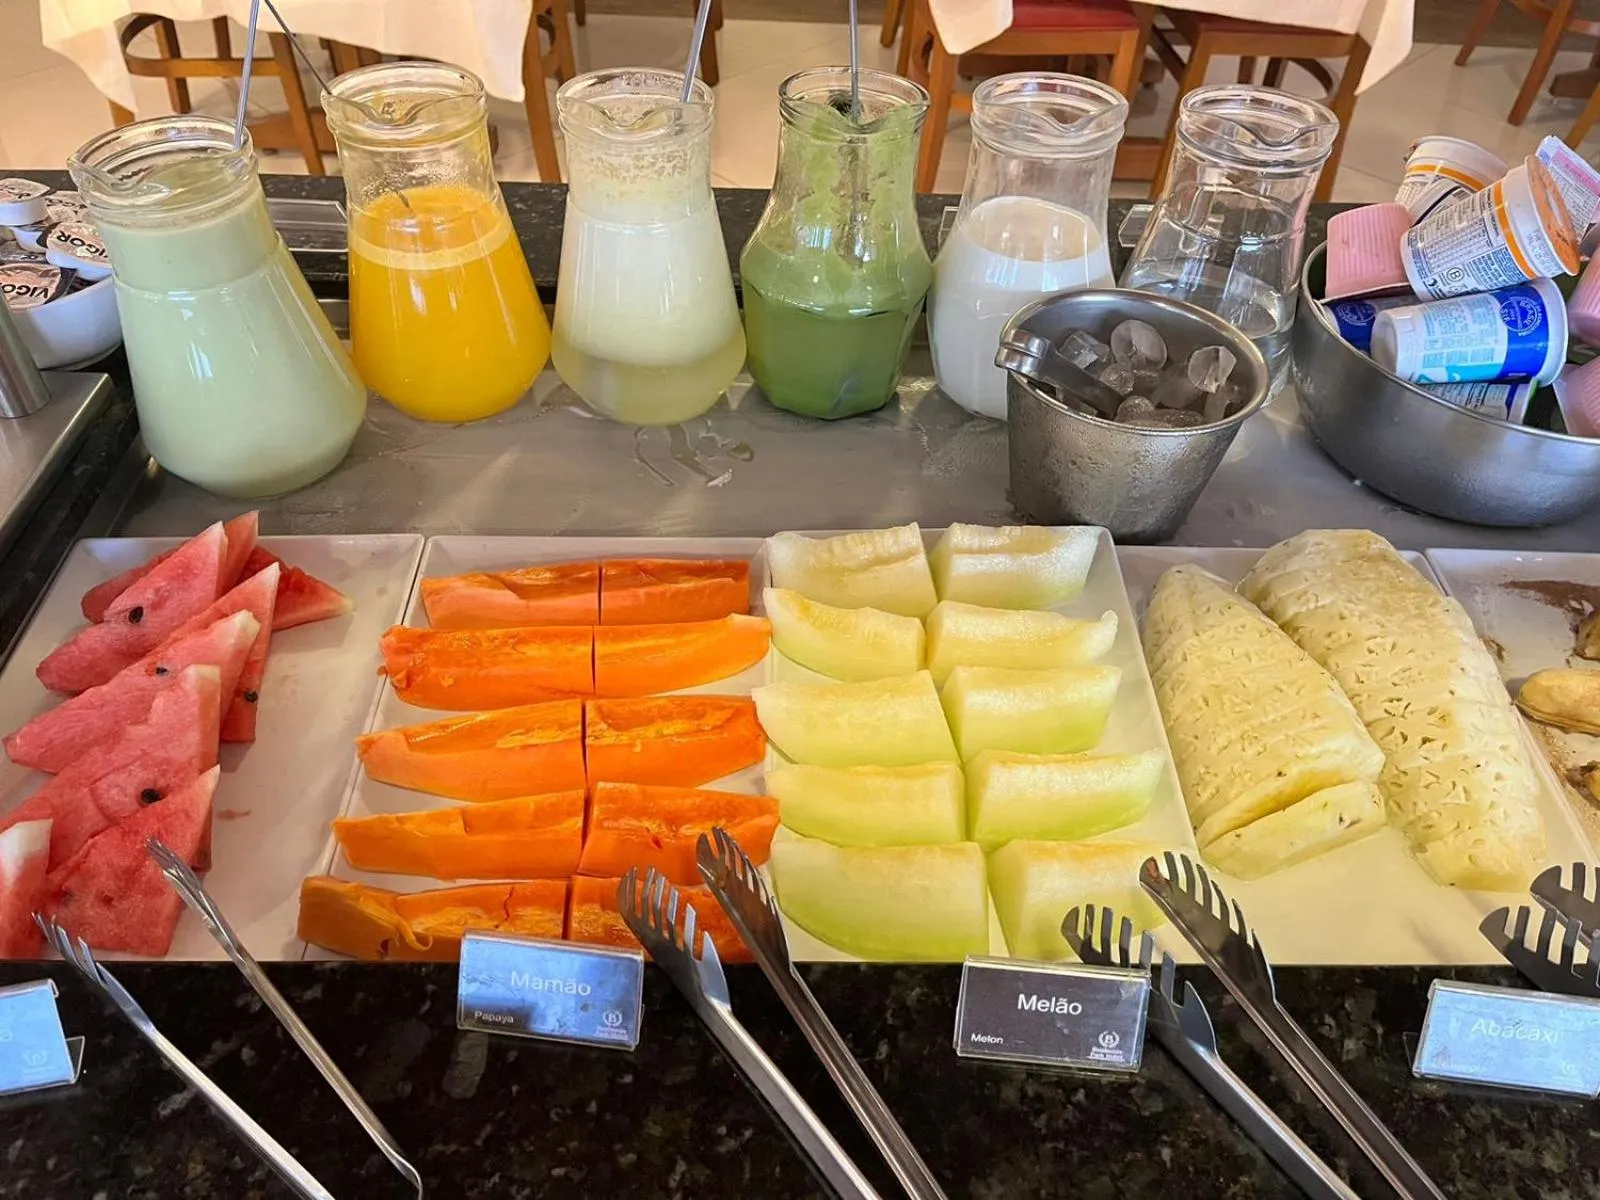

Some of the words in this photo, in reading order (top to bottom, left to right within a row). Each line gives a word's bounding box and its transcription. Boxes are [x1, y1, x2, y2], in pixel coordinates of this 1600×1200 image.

[0, 281, 49, 299] VIGO
[511, 970, 592, 996] Mamão
[1017, 993, 1083, 1016] Melão
[474, 1010, 514, 1024] Papaya
[970, 1033, 1005, 1045] Melon
[1471, 1017, 1560, 1043] Abacaxi
